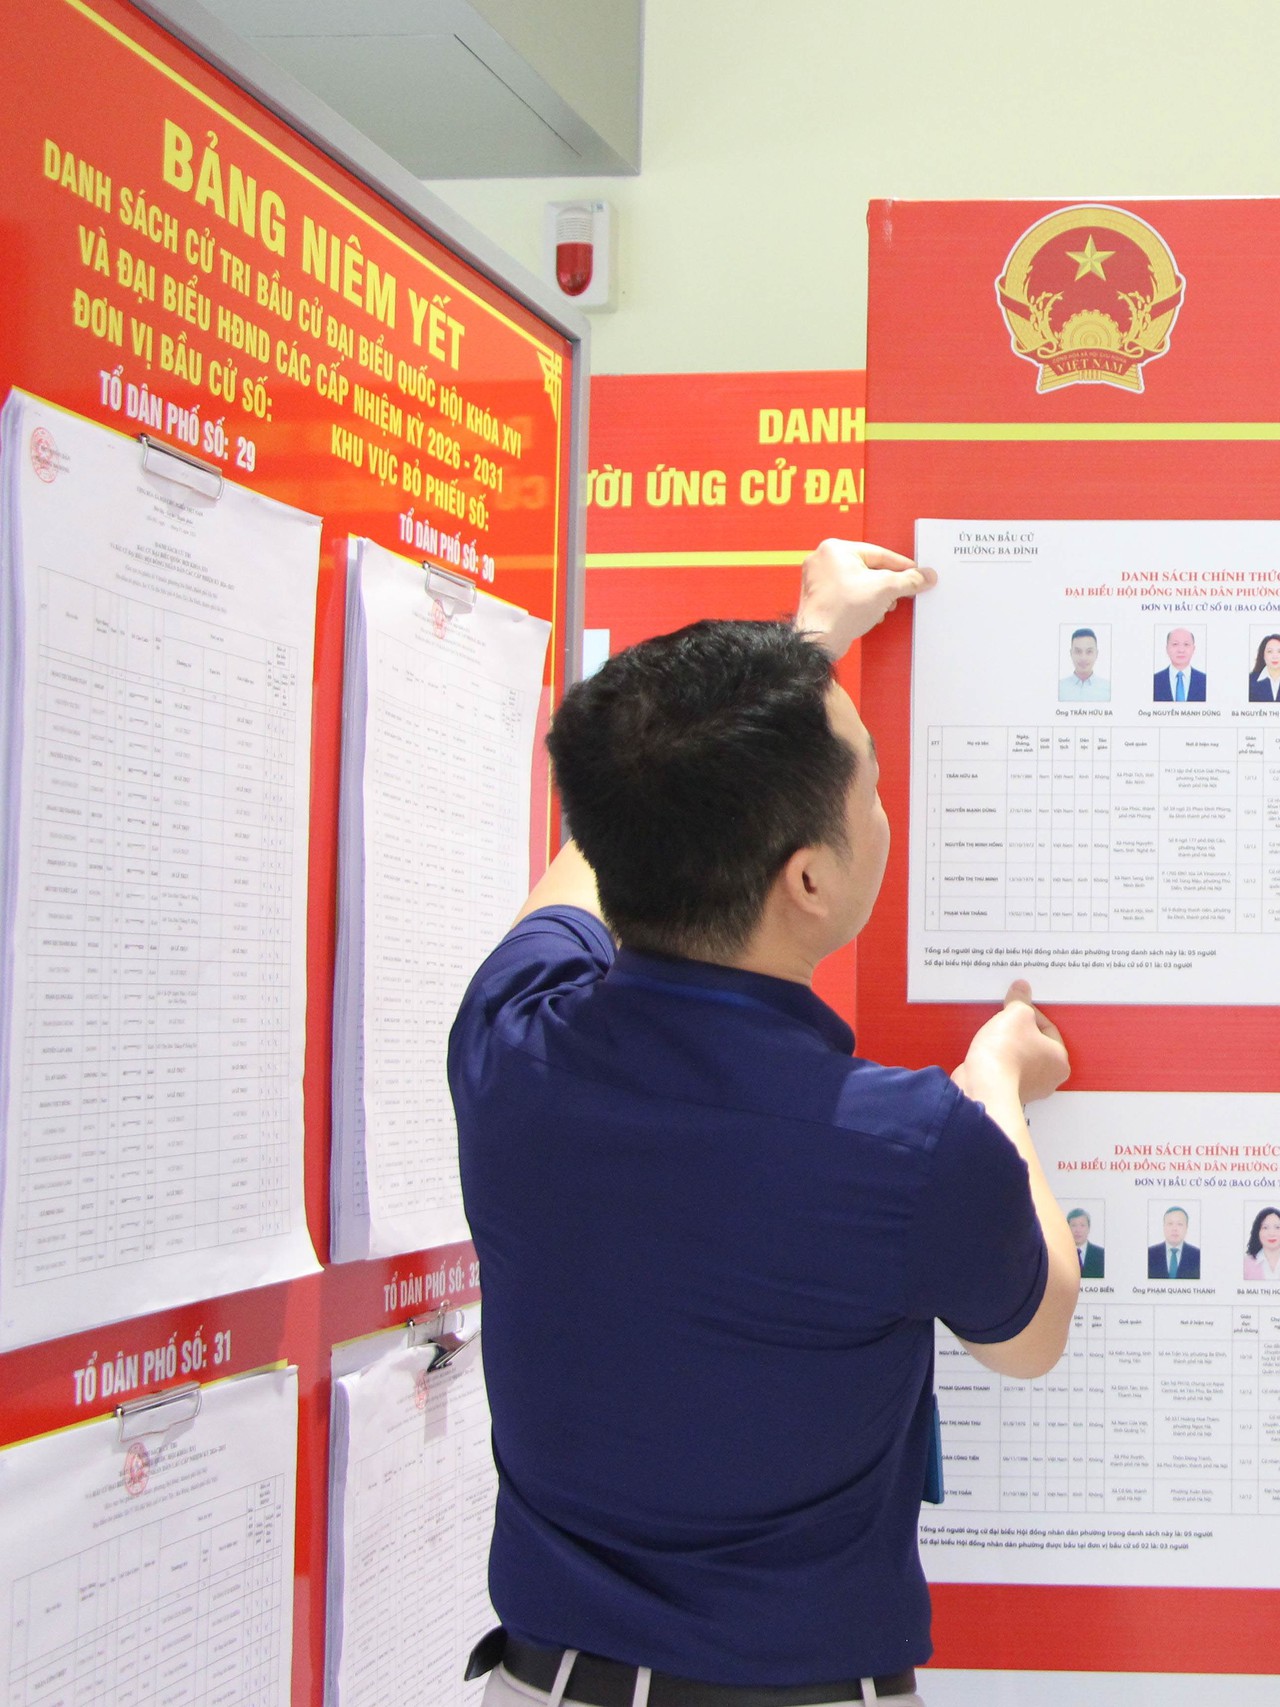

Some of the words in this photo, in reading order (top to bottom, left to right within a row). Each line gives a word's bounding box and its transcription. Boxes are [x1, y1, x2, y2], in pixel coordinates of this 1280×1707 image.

[163, 118, 287, 257] BẢNG
[302, 216, 396, 330] NIÊM
[408, 288, 466, 372] YẾT
[44, 139, 112, 213] DANH
[120, 187, 178, 254] SÁCH
[185, 228, 216, 274] CỬ
[220, 248, 251, 298] TRI
[257, 270, 293, 322] BẦU
[298, 298, 324, 340] CỬ
[326, 315, 355, 362] ĐẠI
[358, 334, 394, 382] BIỂU
[398, 360, 437, 409] QUỐC
[441, 387, 462, 429] HỘI
[466, 401, 499, 447] KHÓA
[502, 421, 522, 459] XVI
[73, 288, 124, 347] ĐƠN
[131, 318, 153, 370] VỊ
[160, 331, 202, 386] BẦU
[209, 358, 237, 403] CỬ
[242, 375, 272, 423] SỐ:
[79, 225, 110, 278] VÀ
[117, 248, 155, 304] ĐẠI
[163, 274, 211, 331] BIỂU
[218, 306, 270, 363] HĐND
[276, 341, 312, 387] CÁC
[317, 358, 349, 406] CẤP
[355, 384, 402, 439] NHIỆM
[406, 413, 425, 449] KỲ
[428, 428, 461, 470] 2026
[473, 454, 504, 495] 2031
[1092, 358, 1124, 373] NAM
[100, 365, 124, 411] TỔ
[127, 383, 163, 431] DÂN
[167, 401, 200, 447] PHỐ
[203, 417, 229, 461] SỐ:
[237, 436, 256, 473] 29
[759, 407, 865, 444] DANH
[331, 424, 363, 468] KHU
[367, 443, 399, 488] VỰC
[402, 459, 423, 498] BỎ
[425, 475, 465, 518] PHIẾU
[469, 494, 489, 531] SỐ:
[647, 464, 726, 507] ỨNG
[740, 458, 797, 506] CỬ
[400, 507, 414, 543] TỔ
[416, 520, 438, 555] DÂN
[440, 531, 460, 565] PHỐ
[463, 540, 478, 573] SỐ:
[482, 555, 494, 583] 30
[954, 546, 995, 554] PHƯỜNG
[1014, 545, 1038, 554] ĐÌNH
[959, 531, 971, 541] ỦY
[998, 531, 1017, 541] BẦU
[1020, 532, 1034, 541] CỬ
[1065, 587, 1084, 598] ĐẠI
[1088, 584, 1112, 596] BIỂU
[1117, 586, 1137, 598] HỘI
[1140, 585, 1172, 596] ĐỒNG
[1176, 586, 1207, 597] NHÂN
[1210, 586, 1233, 597] DÂN
[1121, 572, 1158, 581] DANH
[1162, 570, 1197, 581] SÁCH
[1202, 570, 1244, 581] CHÍNH
[1114, 1145, 1152, 1155] DANH
[1156, 1143, 1191, 1155] SÁCH
[1196, 1143, 1239, 1156] CHÍNH
[1243, 1143, 1280, 1156] THỨC
[1135, 1178, 1154, 1186] ĐƠN
[1156, 1179, 1167, 1188] VỊ
[1169, 1176, 1186, 1186] BẦU
[1189, 1177, 1201, 1186] CỬ
[1204, 1176, 1216, 1187] SỐ
[1218, 1179, 1227, 1187] 02
[1253, 1176, 1275, 1187] GỒM
[384, 1271, 398, 1312] TỔ
[401, 1272, 422, 1307] DÂN
[426, 1260, 446, 1300] PHỐ
[449, 1256, 464, 1293] SỐ:
[469, 1261, 480, 1288] 32
[74, 1350, 98, 1405] TỔ
[102, 1350, 138, 1398] DÂN
[144, 1331, 177, 1385] PHỐ
[181, 1325, 207, 1373] SỐ:
[214, 1330, 231, 1364] 31
